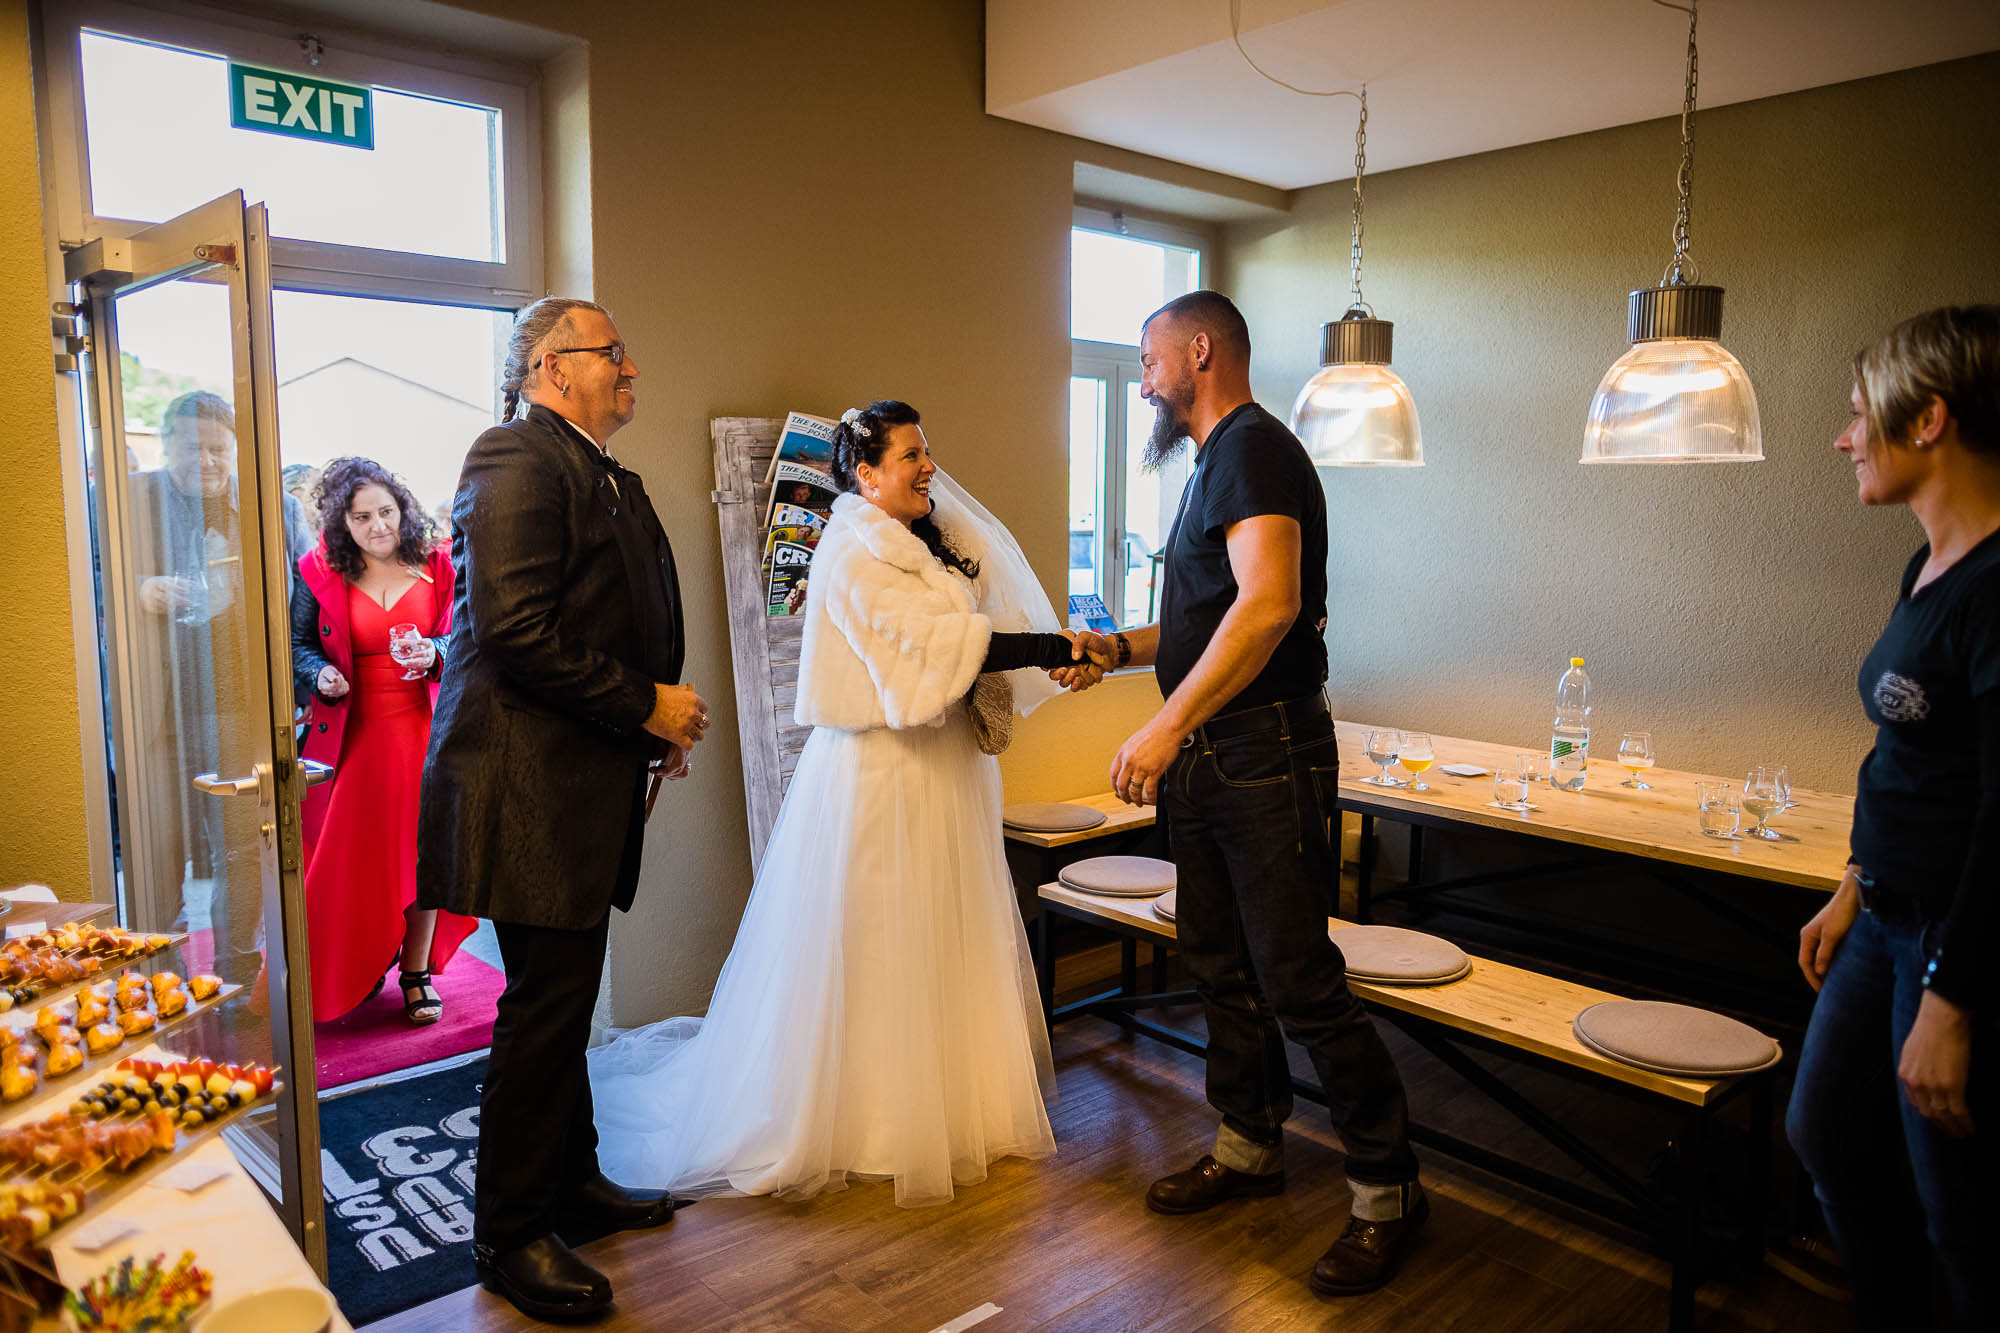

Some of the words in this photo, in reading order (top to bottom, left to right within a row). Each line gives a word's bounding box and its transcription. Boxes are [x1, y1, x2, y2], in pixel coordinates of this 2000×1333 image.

[243, 75, 364, 137] EXIT
[792, 415, 809, 425] THE
[781, 464, 799, 472] THE
[798, 475, 824, 486] POST
[776, 547, 810, 566] CR
[1074, 597, 1103, 608] MEGA
[1080, 607, 1107, 617] DEAL
